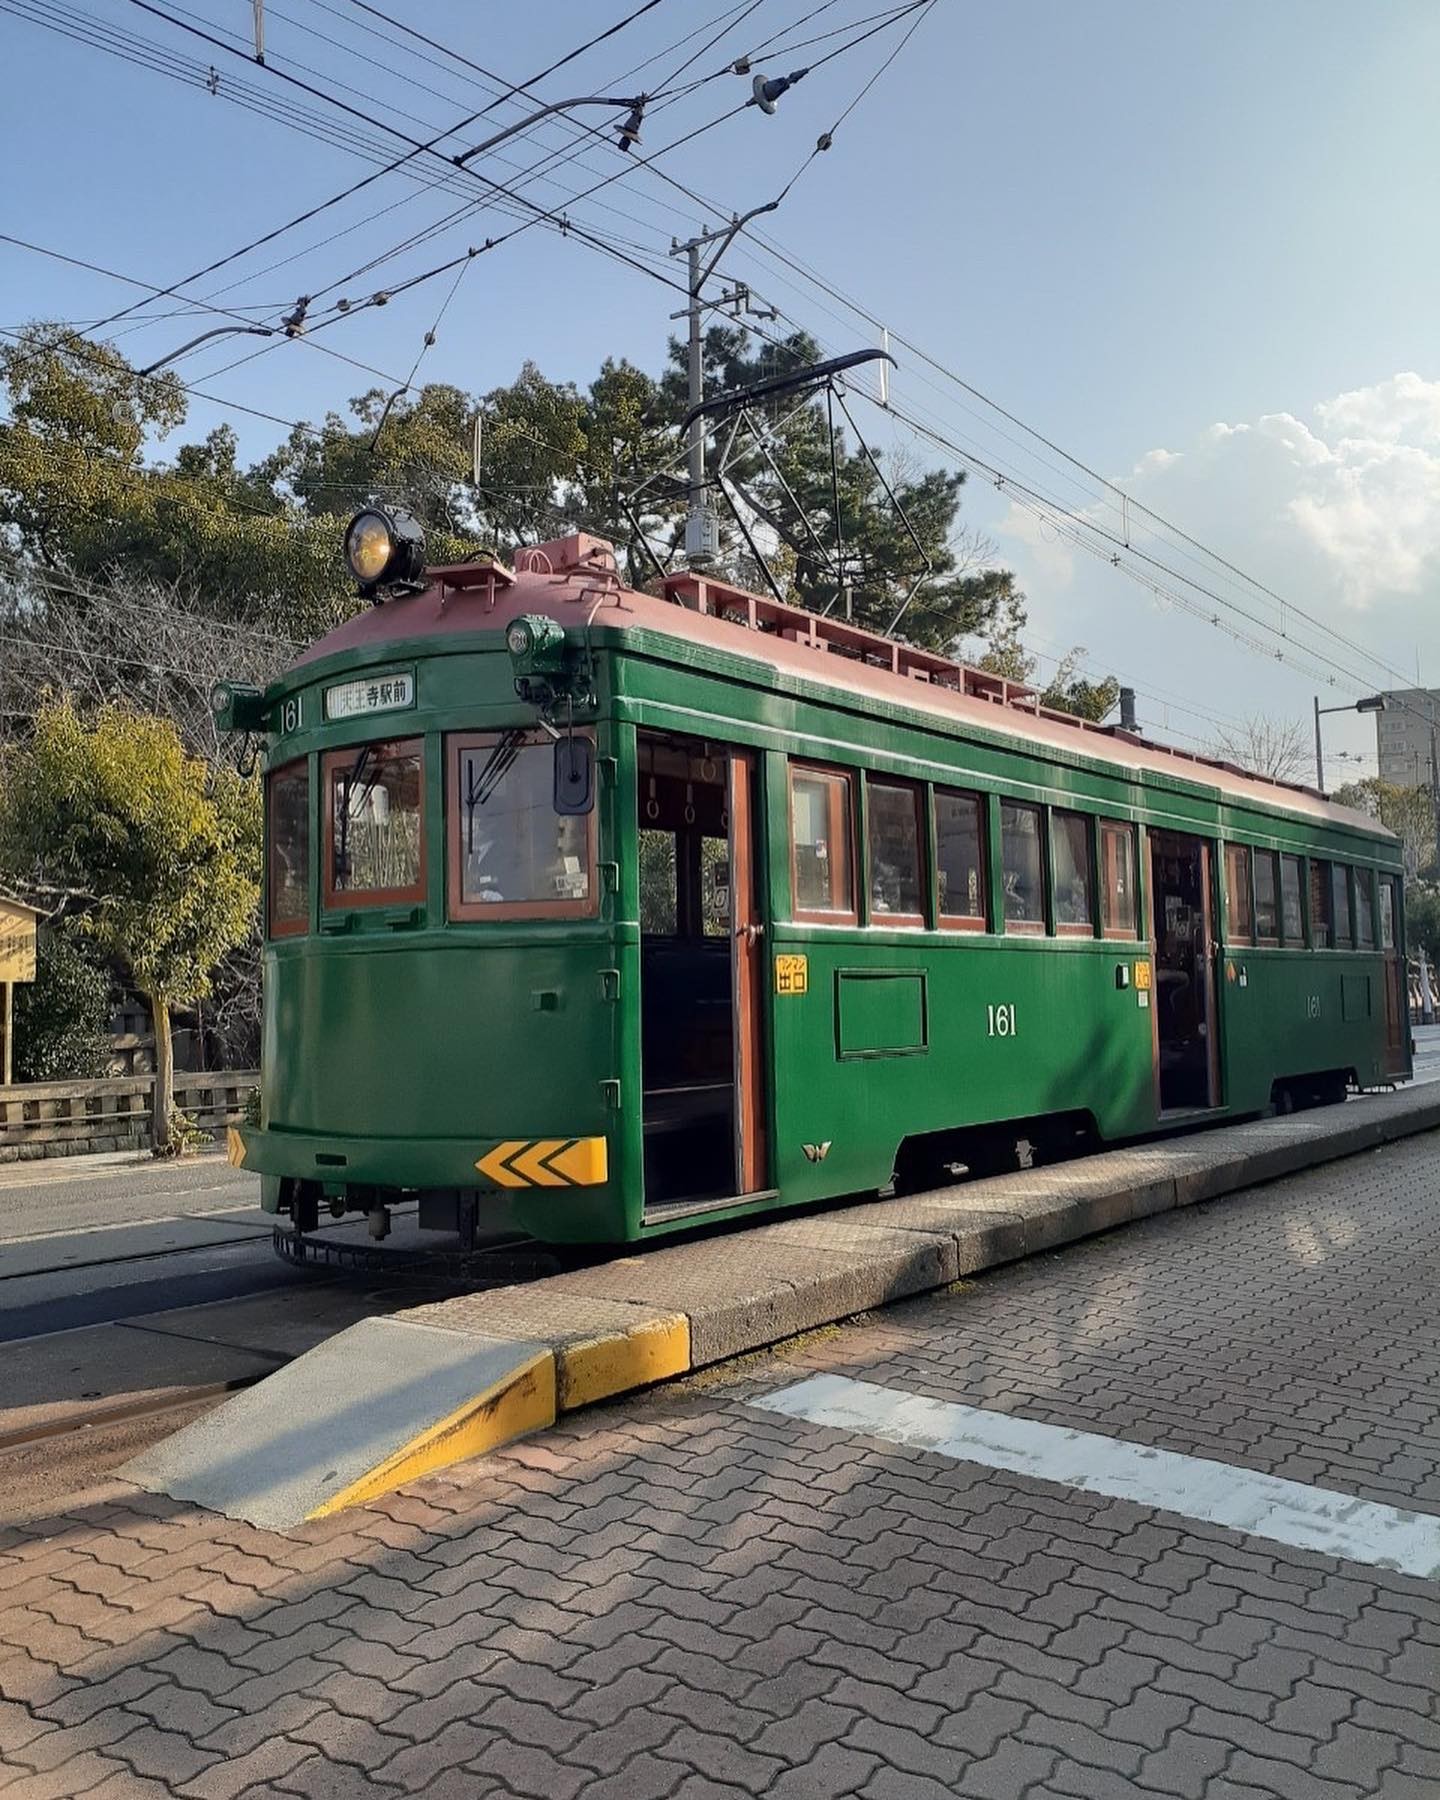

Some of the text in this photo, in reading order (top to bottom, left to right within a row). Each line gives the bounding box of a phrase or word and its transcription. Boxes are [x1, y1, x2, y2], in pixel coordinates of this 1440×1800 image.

[341, 681, 406, 711] 天王寺駅前
[280, 696, 302, 736] 161
[779, 971, 805, 991] 出口
[988, 1004, 1016, 1036] 161
